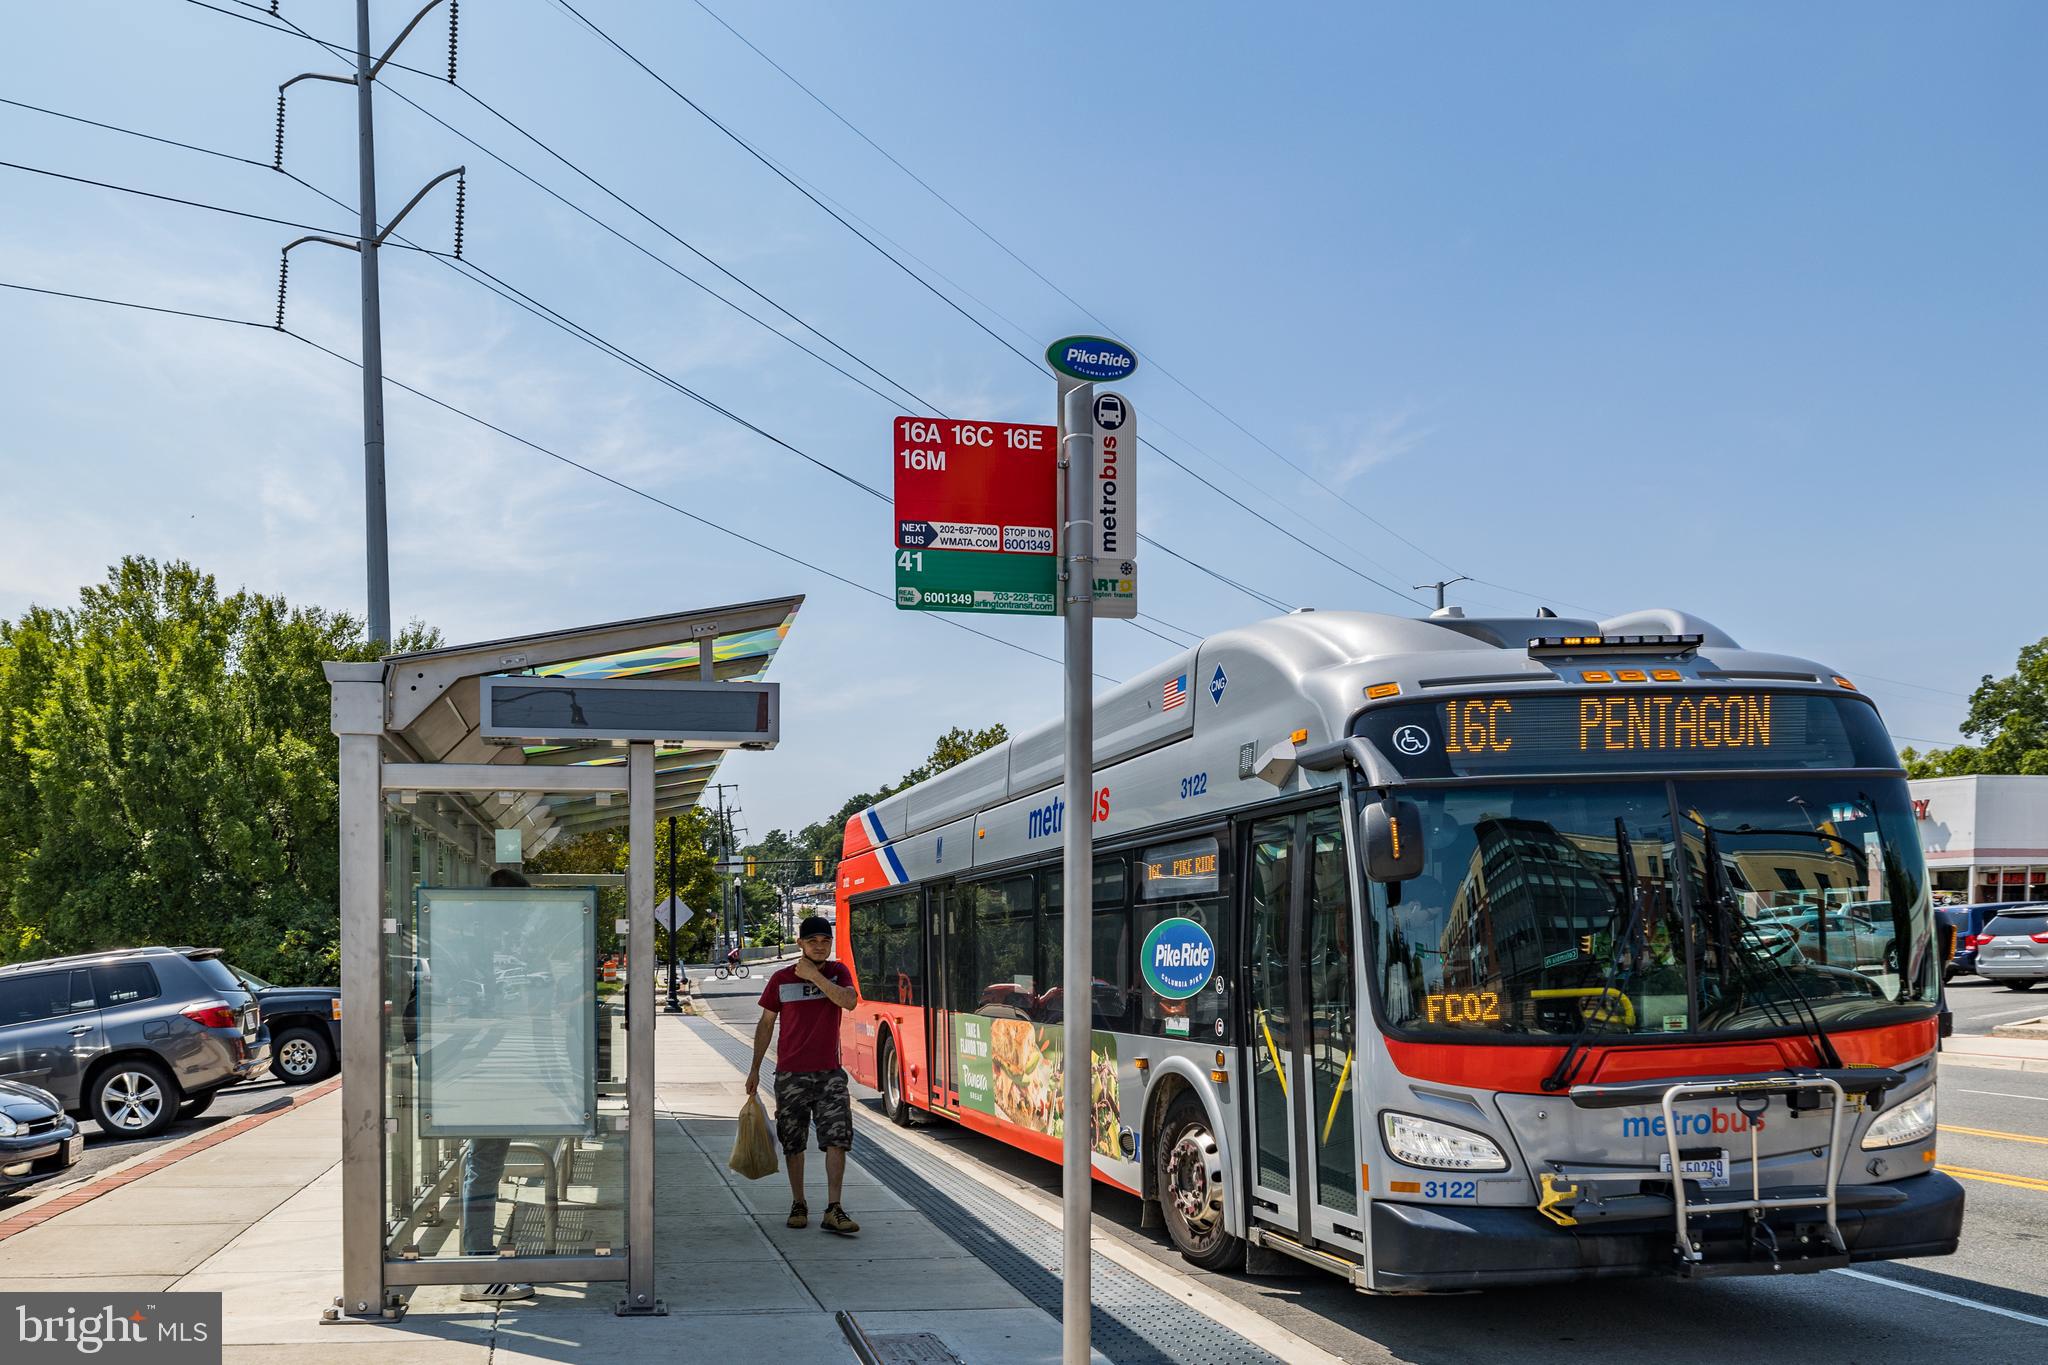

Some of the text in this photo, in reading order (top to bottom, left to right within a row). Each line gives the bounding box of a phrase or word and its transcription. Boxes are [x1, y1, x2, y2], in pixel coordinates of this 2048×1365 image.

[1073, 365, 1106, 376] COLUMBIA
[900, 421, 1043, 450] 16A 16C 16E
[900, 449, 946, 471] 16M
[1099, 435, 1117, 552] metrobus
[902, 523, 927, 533] NEXT
[939, 525, 998, 536] 202-637-7000
[1004, 528, 1025, 538] STOP
[1027, 529, 1036, 538] ID
[904, 535, 925, 545] BUS
[939, 537, 998, 548] WMATA.COM
[1004, 539, 1051, 551] 6001349
[897, 551, 923, 572] 41
[899, 589, 915, 597] REAL
[923, 592, 972, 605] 6001349
[992, 592, 1053, 603] 703-228-RIDE
[974, 600, 1053, 611] arlingtontransit.com
[1211, 677, 1225, 693] CNG
[1446, 695, 1771, 752] 16C PENTAGON
[1180, 772, 1208, 800] 3122
[1028, 785, 1111, 840] metrus
[1148, 854, 1217, 881] 16C PIKE RIDE
[1161, 971, 1204, 988] COLUMBIA PIKE
[1427, 992, 1500, 1023] FC02
[964, 1022, 977, 1038] TAKE
[960, 1038, 988, 1057] FLAVOR TRIP
[962, 1064, 988, 1092] Panera
[1623, 1107, 1766, 1138] metrobus
[1424, 1181, 1476, 1199] 3122
